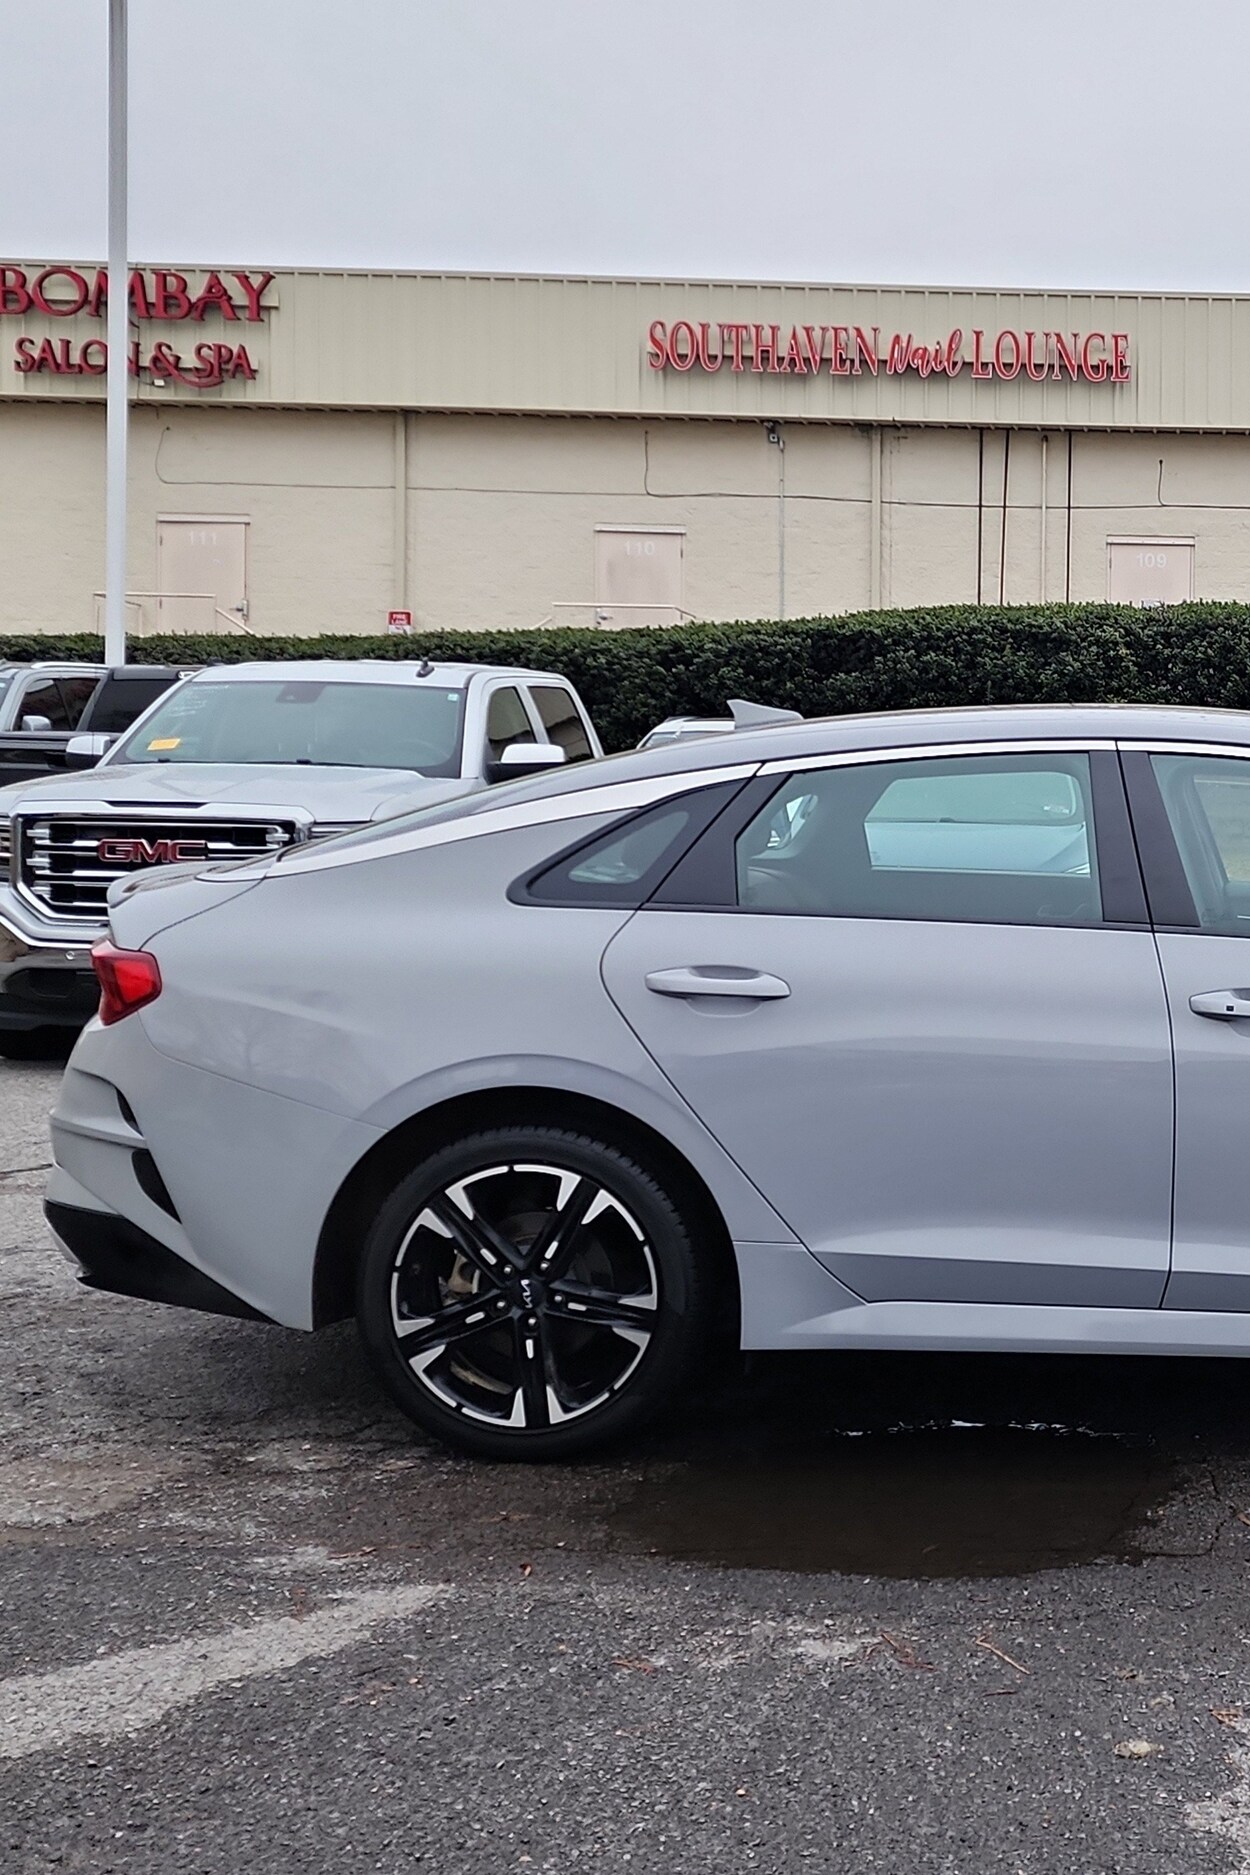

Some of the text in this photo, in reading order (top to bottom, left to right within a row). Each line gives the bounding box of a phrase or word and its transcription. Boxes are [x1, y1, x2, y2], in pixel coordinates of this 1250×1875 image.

[0, 266, 275, 322] BOMBAY
[193, 342, 256, 380] SPA
[648, 320, 1132, 382] SOUTHAVEN Nail LOUNGE
[624, 540, 655, 556] 110
[1137, 552, 1167, 568] 109
[98, 838, 208, 863] GMC
